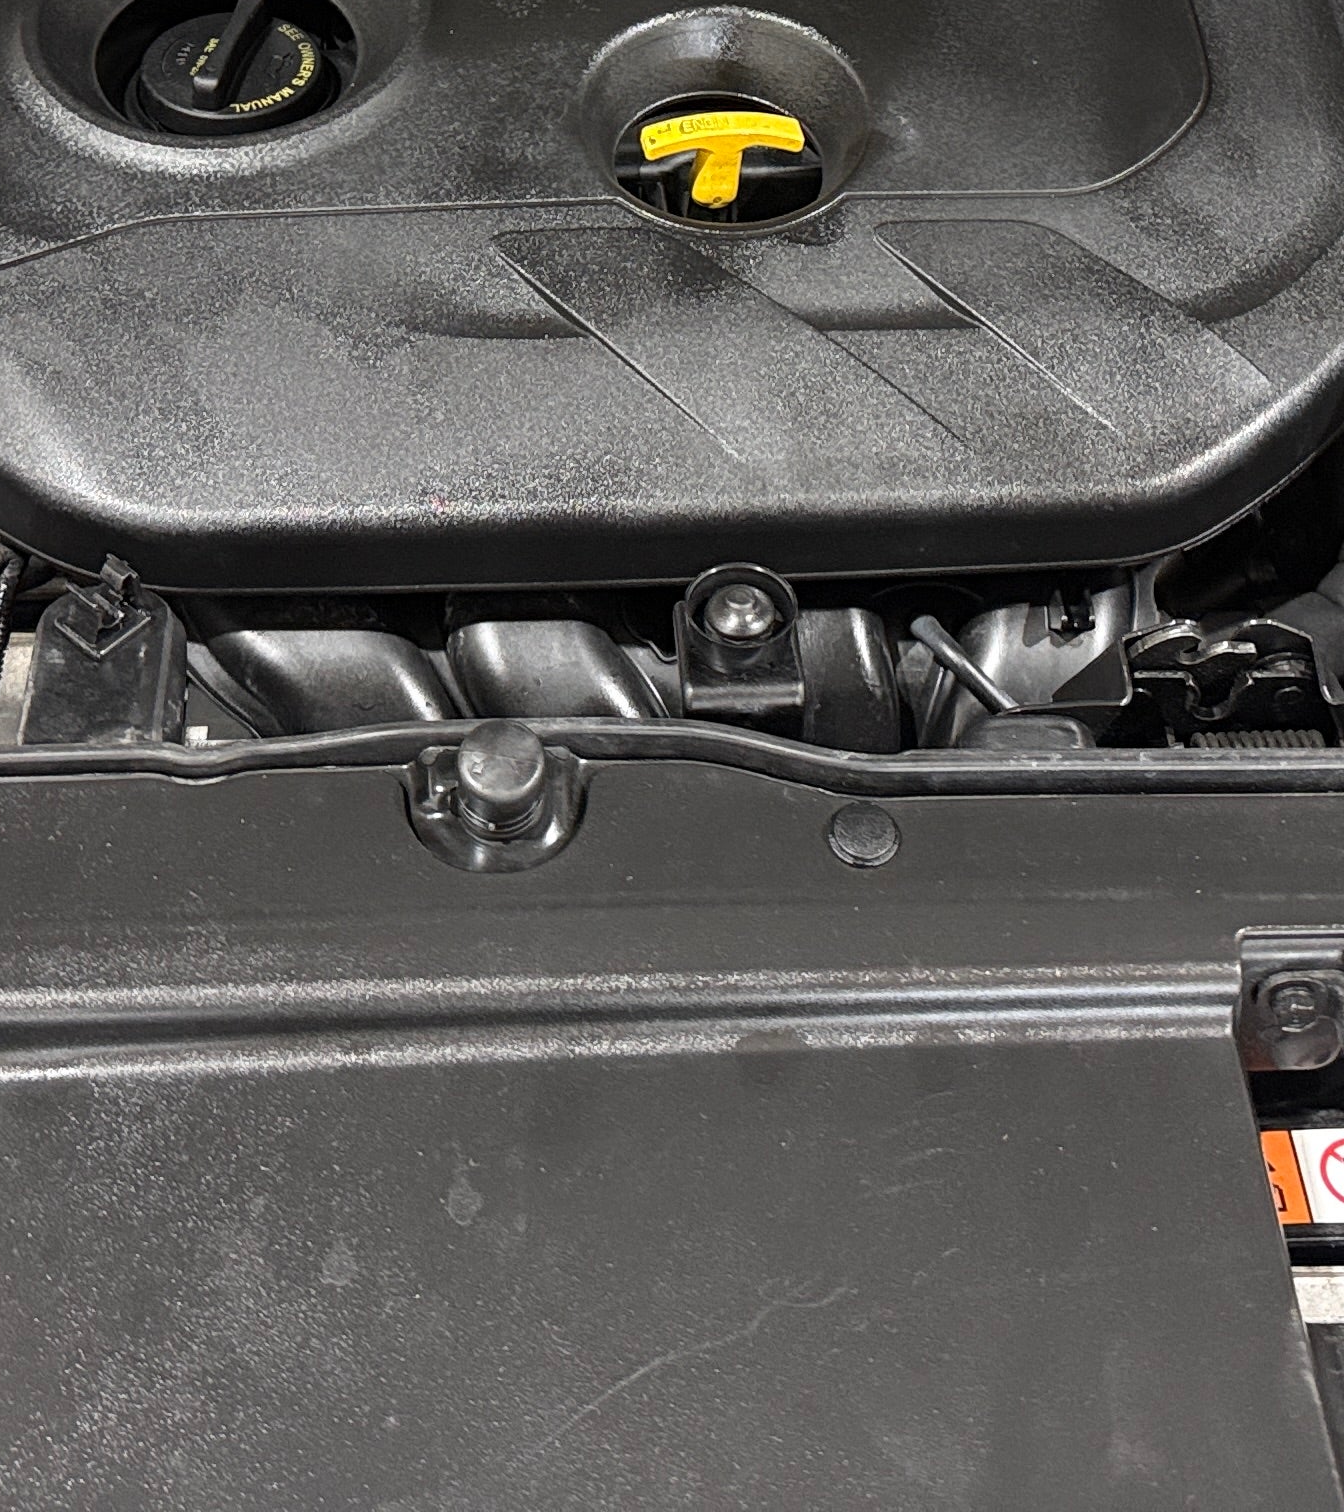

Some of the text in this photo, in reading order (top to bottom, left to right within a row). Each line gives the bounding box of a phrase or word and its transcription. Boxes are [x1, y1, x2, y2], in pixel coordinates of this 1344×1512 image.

[229, 23, 317, 113] SEE OWNER'S MANUAL
